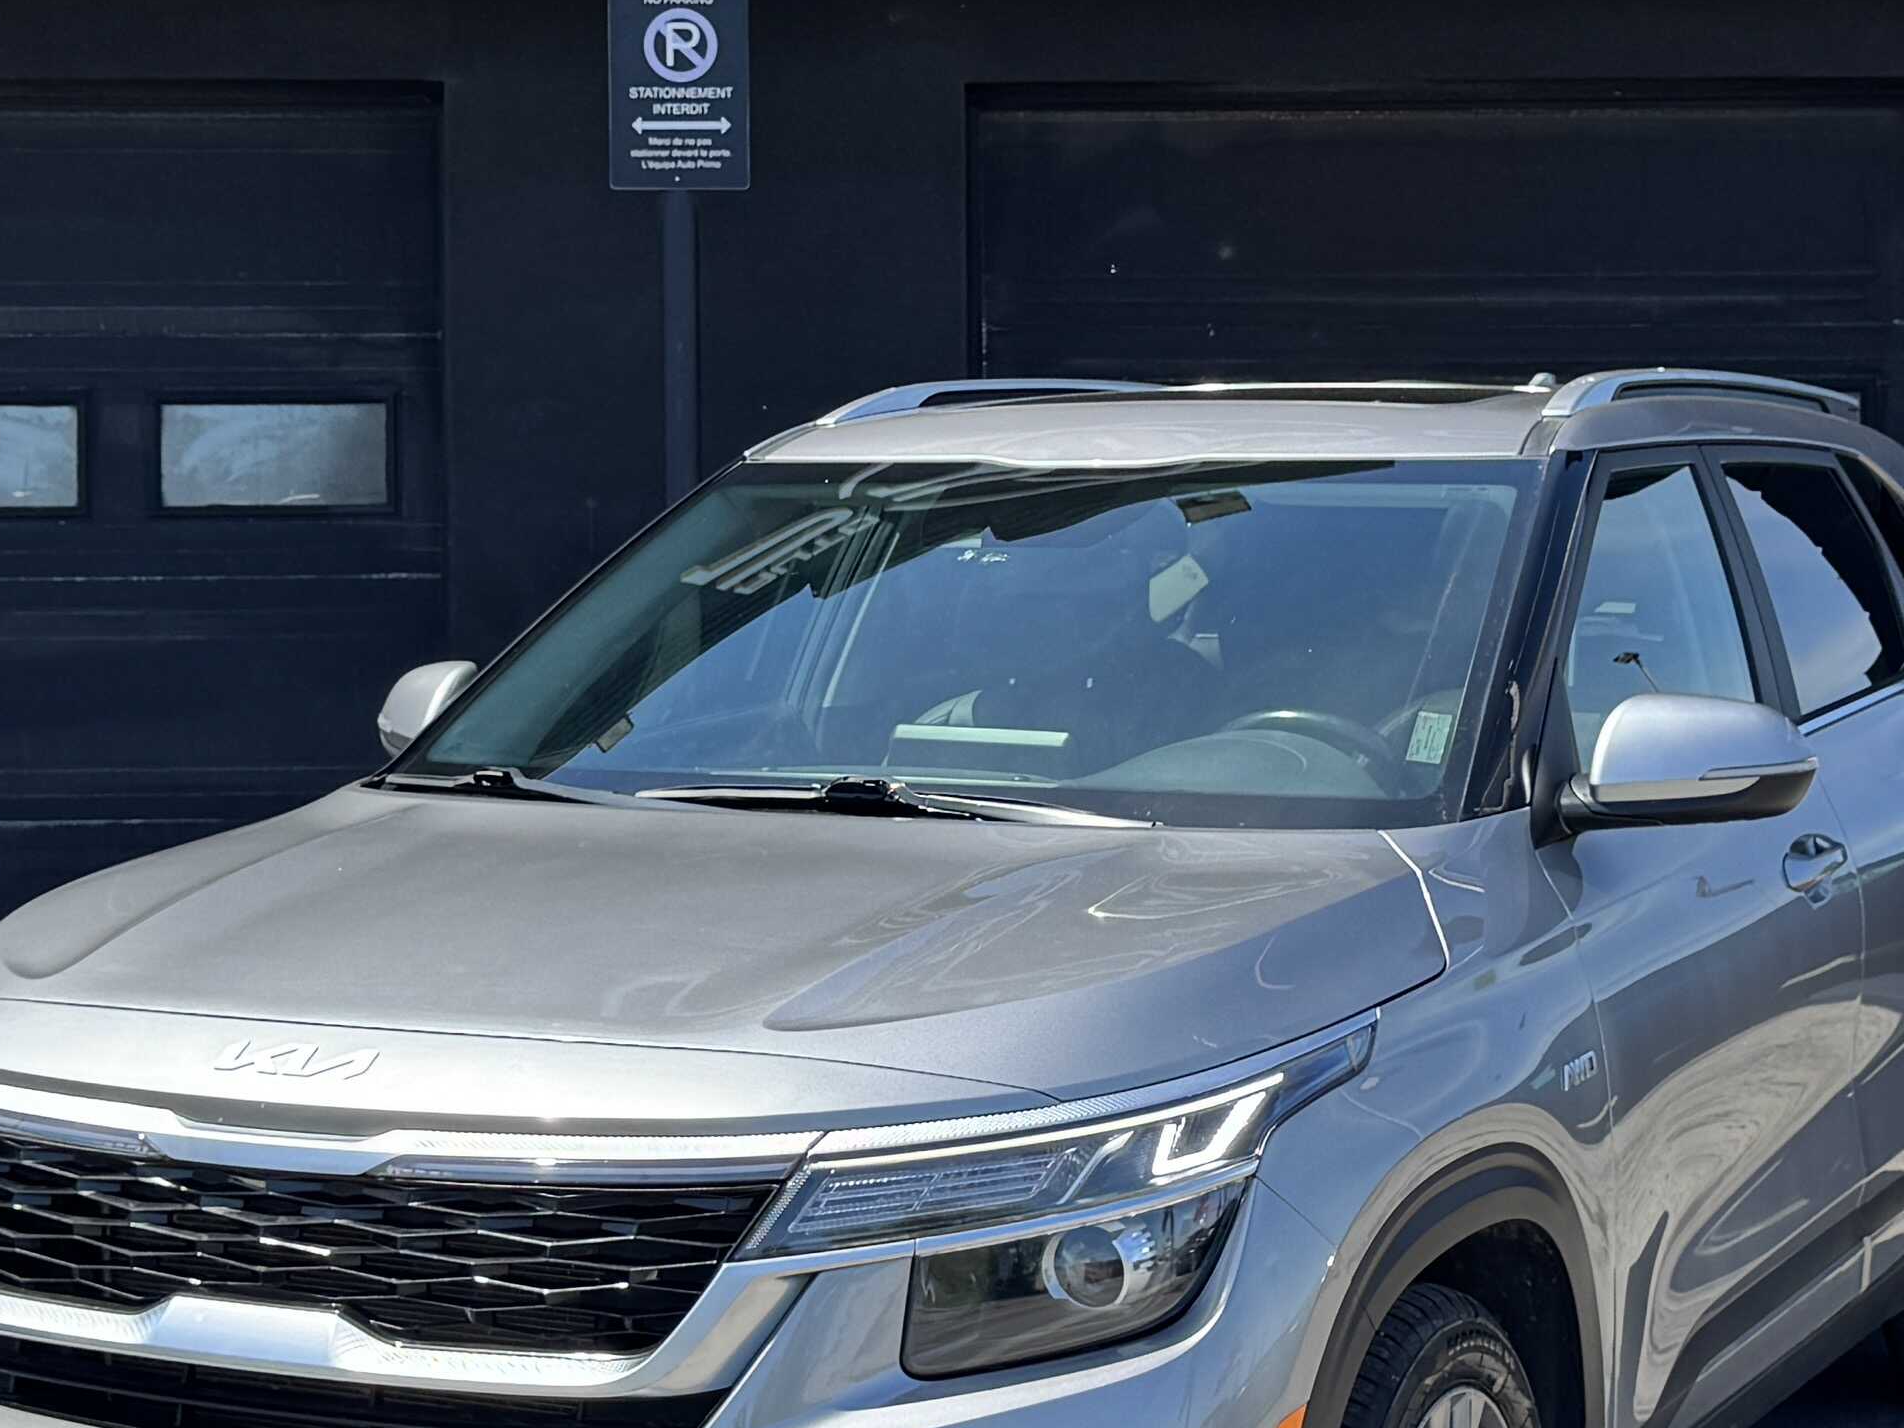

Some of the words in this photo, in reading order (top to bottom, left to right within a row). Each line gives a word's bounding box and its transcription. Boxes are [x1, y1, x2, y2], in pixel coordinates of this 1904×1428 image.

[628, 86, 734, 99] STATIONNEMENT
[652, 103, 710, 115] INTERDIT
[1562, 1050, 1598, 1091] AWD
